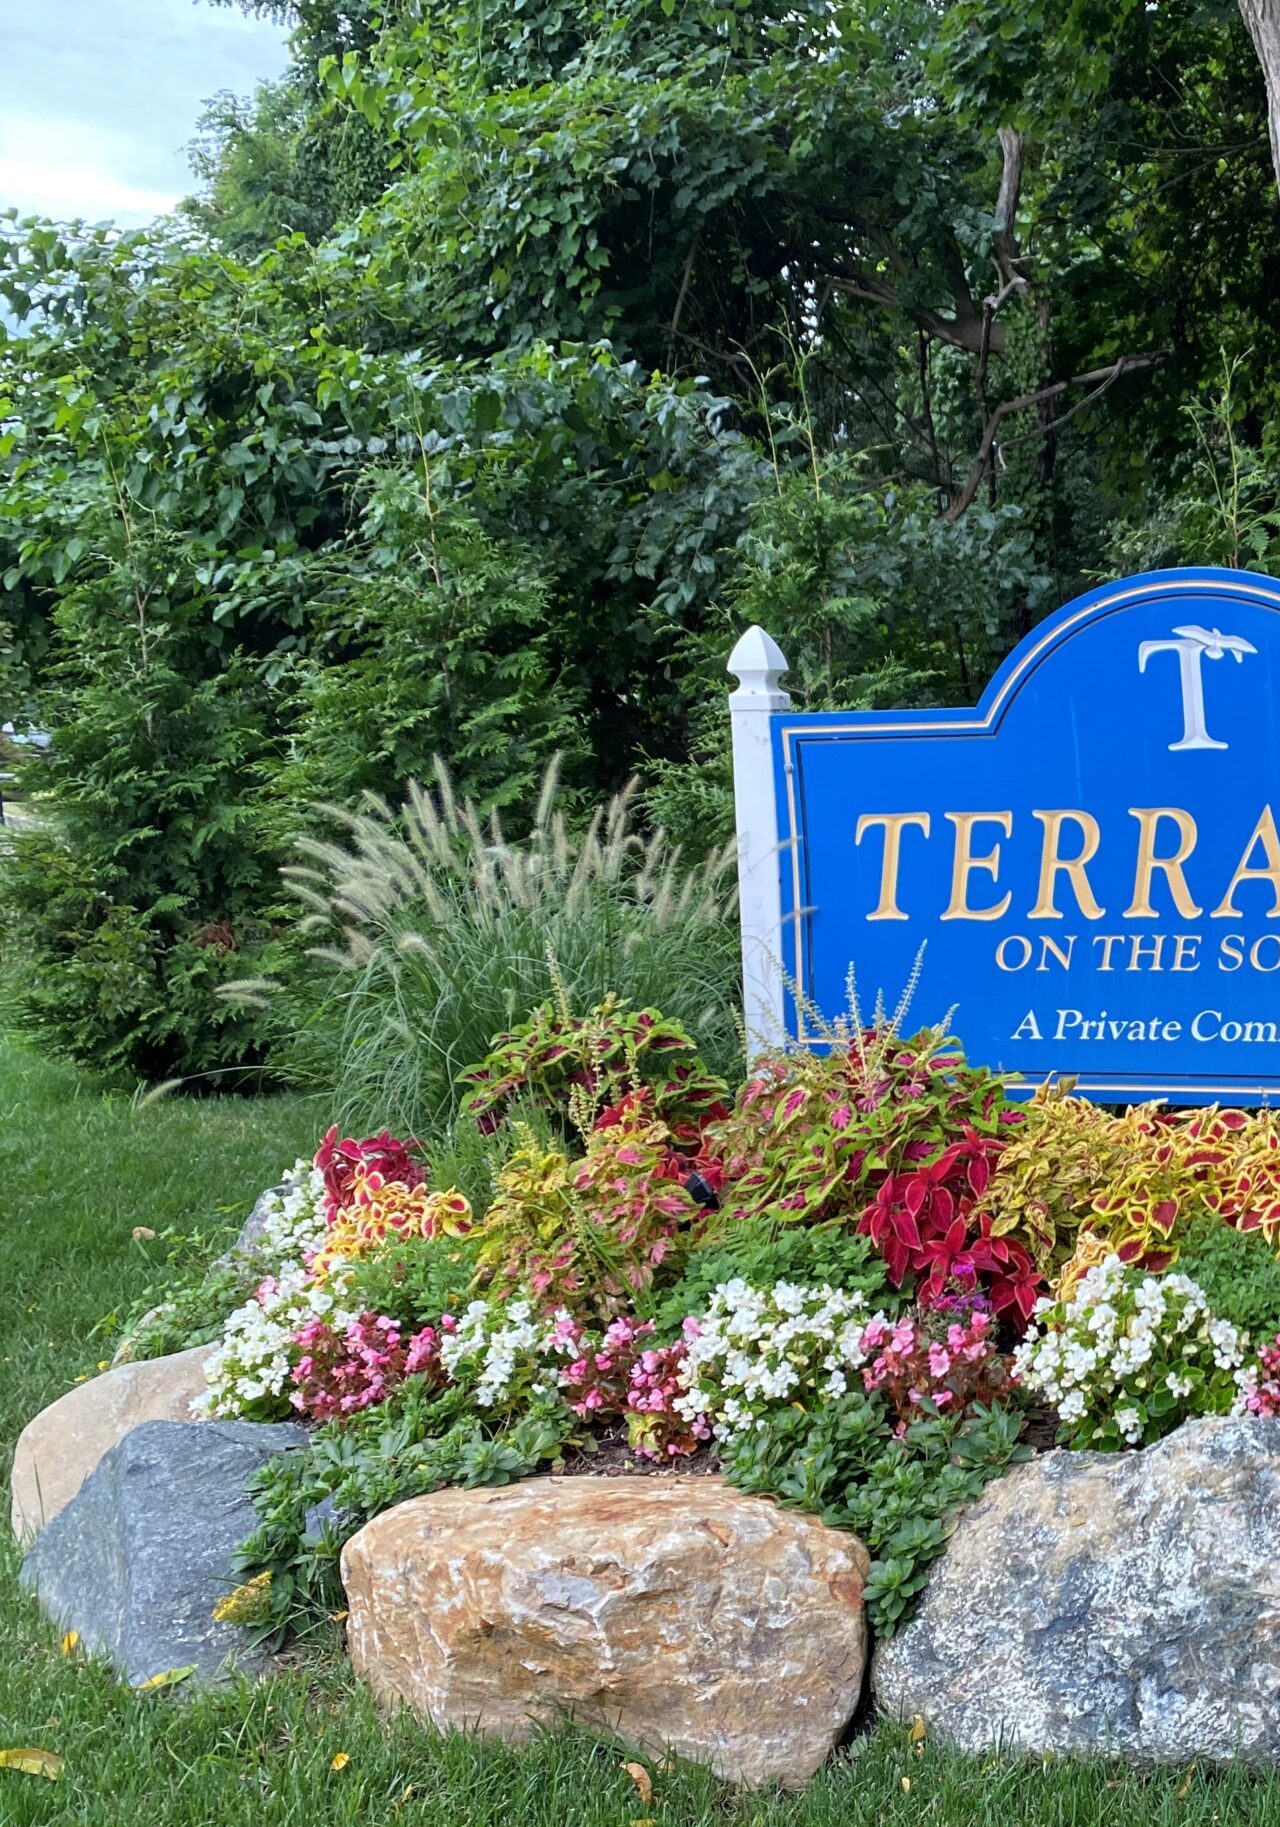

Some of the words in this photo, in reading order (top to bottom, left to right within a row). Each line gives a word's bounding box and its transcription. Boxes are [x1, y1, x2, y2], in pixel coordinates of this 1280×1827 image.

[1138, 625, 1258, 751] T
[995, 935, 1079, 972] ON
[1093, 935, 1203, 972] THE
[1012, 1010, 1043, 1040] A
[1053, 1009, 1182, 1041] Private
